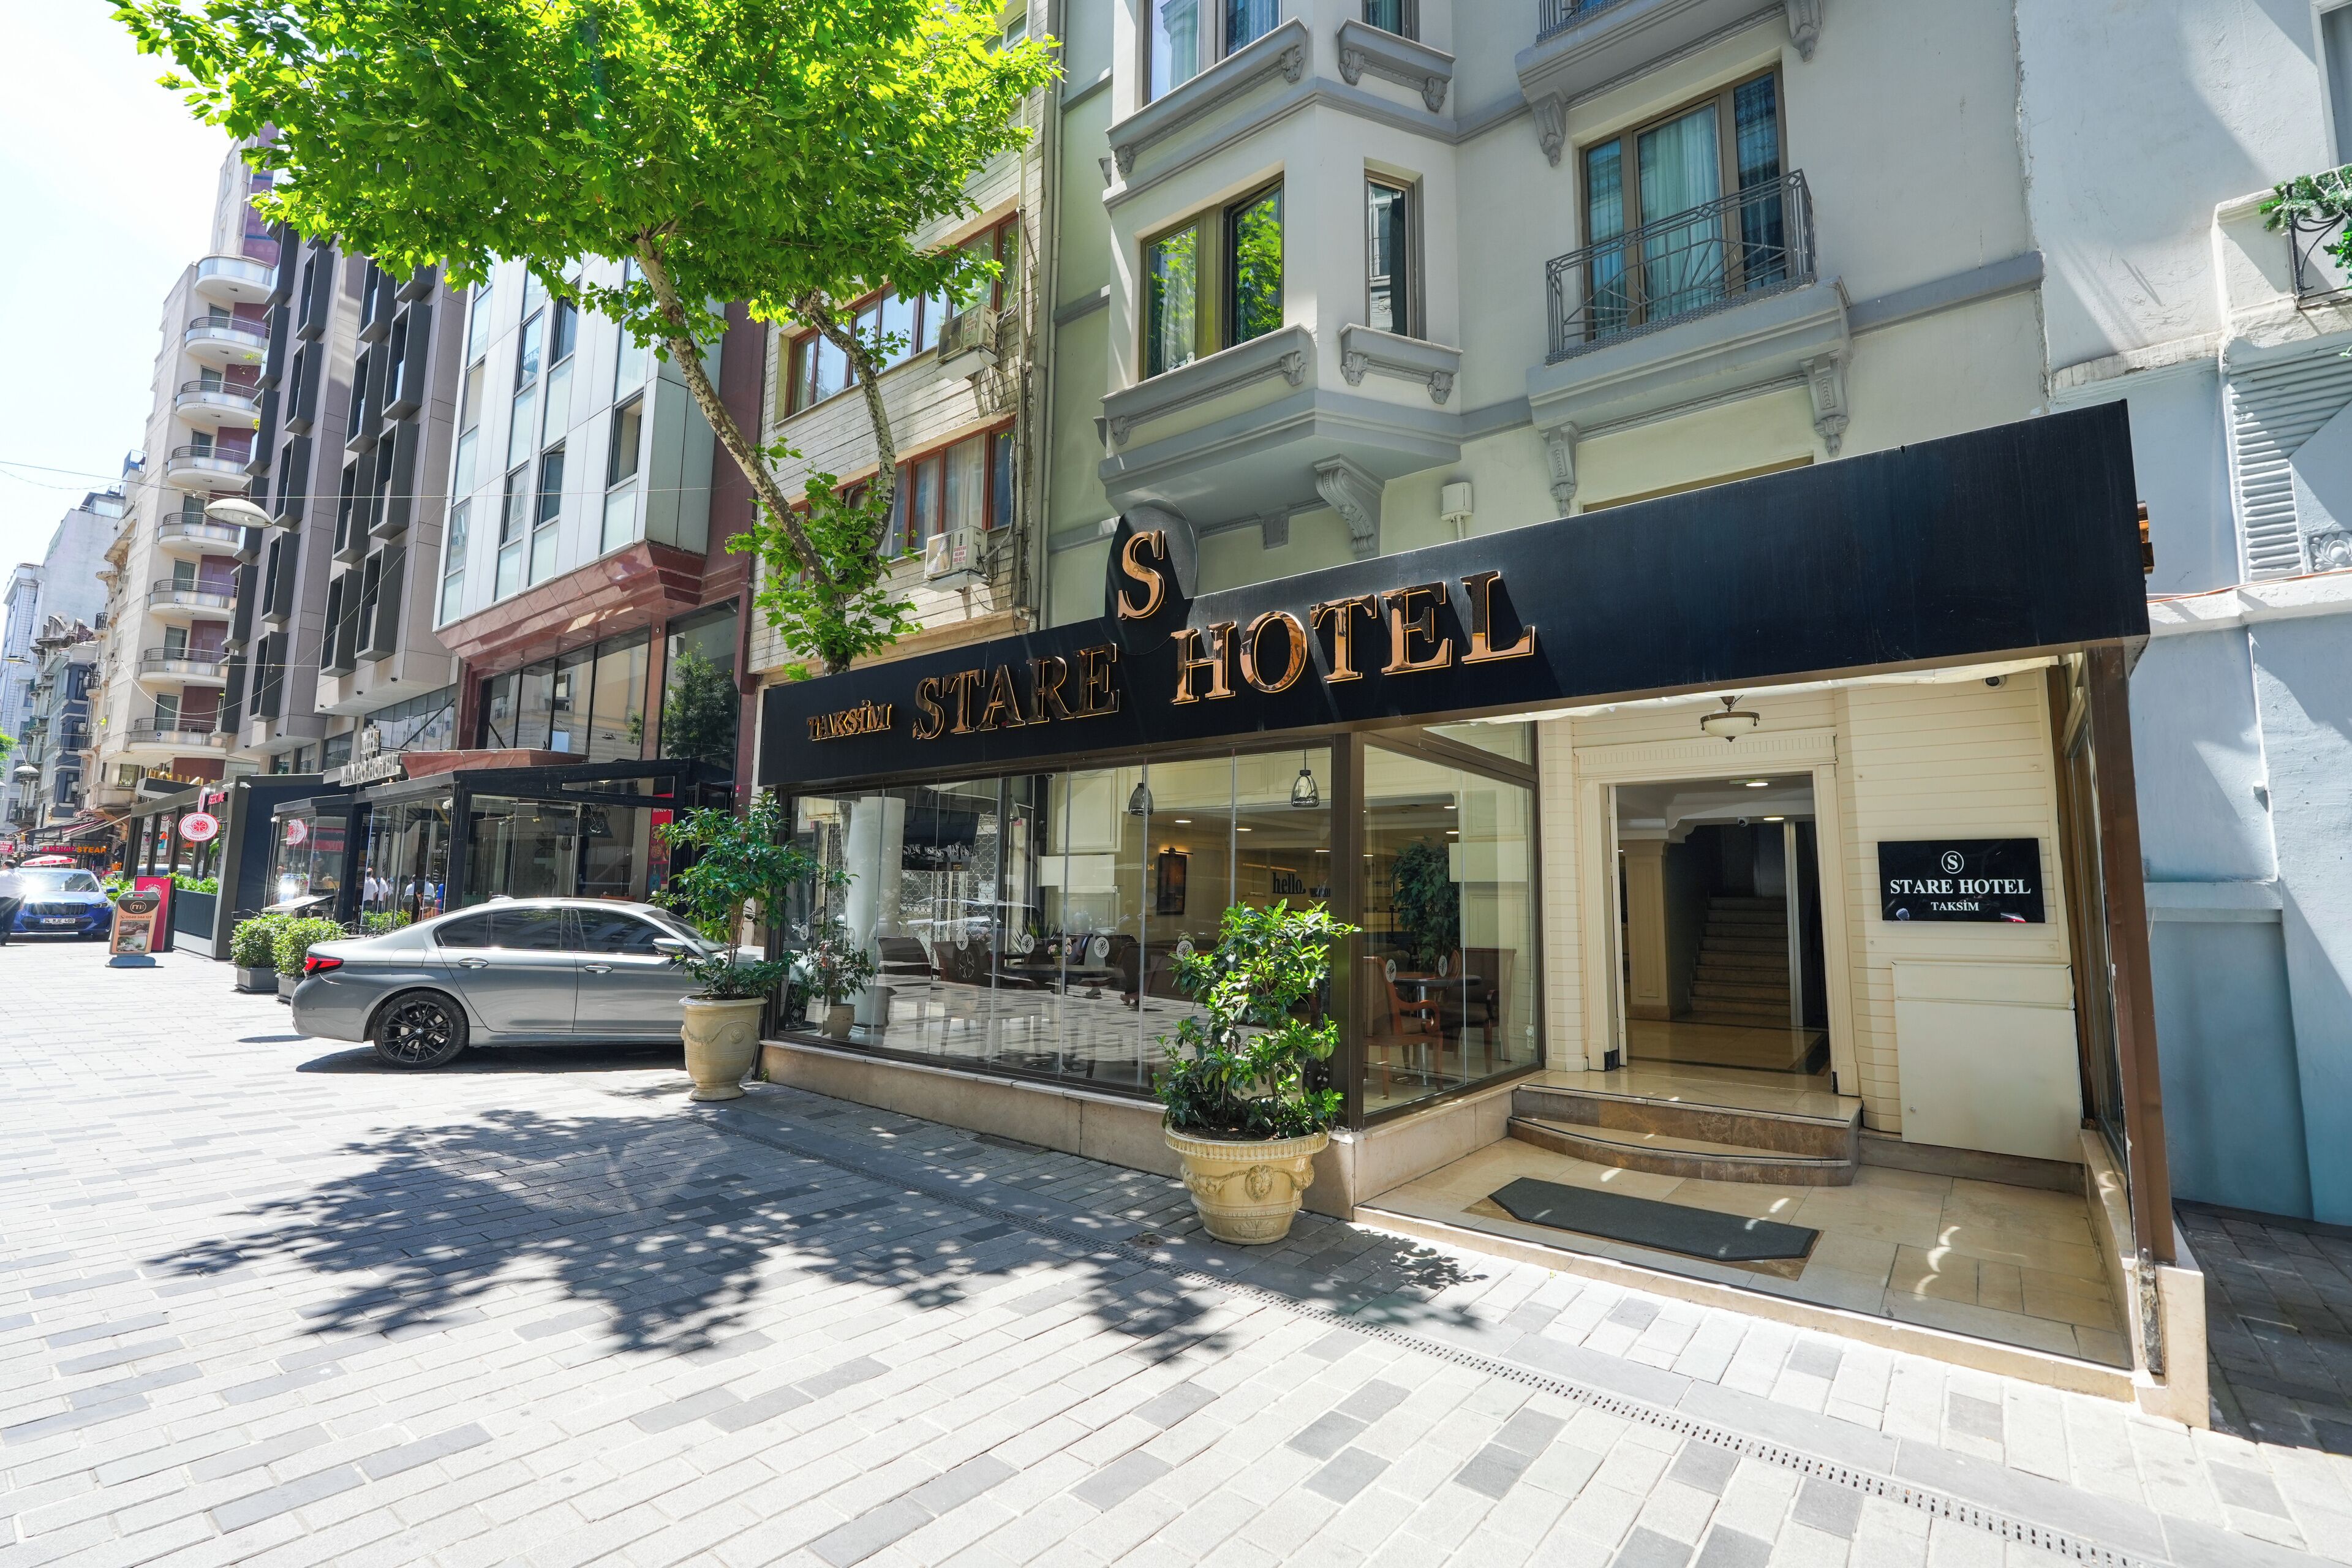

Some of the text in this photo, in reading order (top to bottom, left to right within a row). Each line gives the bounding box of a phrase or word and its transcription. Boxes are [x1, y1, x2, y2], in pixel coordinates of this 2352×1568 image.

[1118, 530, 1165, 620] S
[807, 570, 1536, 741] TAKSİM STARE HOTEL
[367, 753, 401, 778] HOTEL
[1947, 854, 1959, 870] S
[1890, 878, 2032, 894] STARE HOTEL
[1931, 899, 1980, 911] TAKSİM
